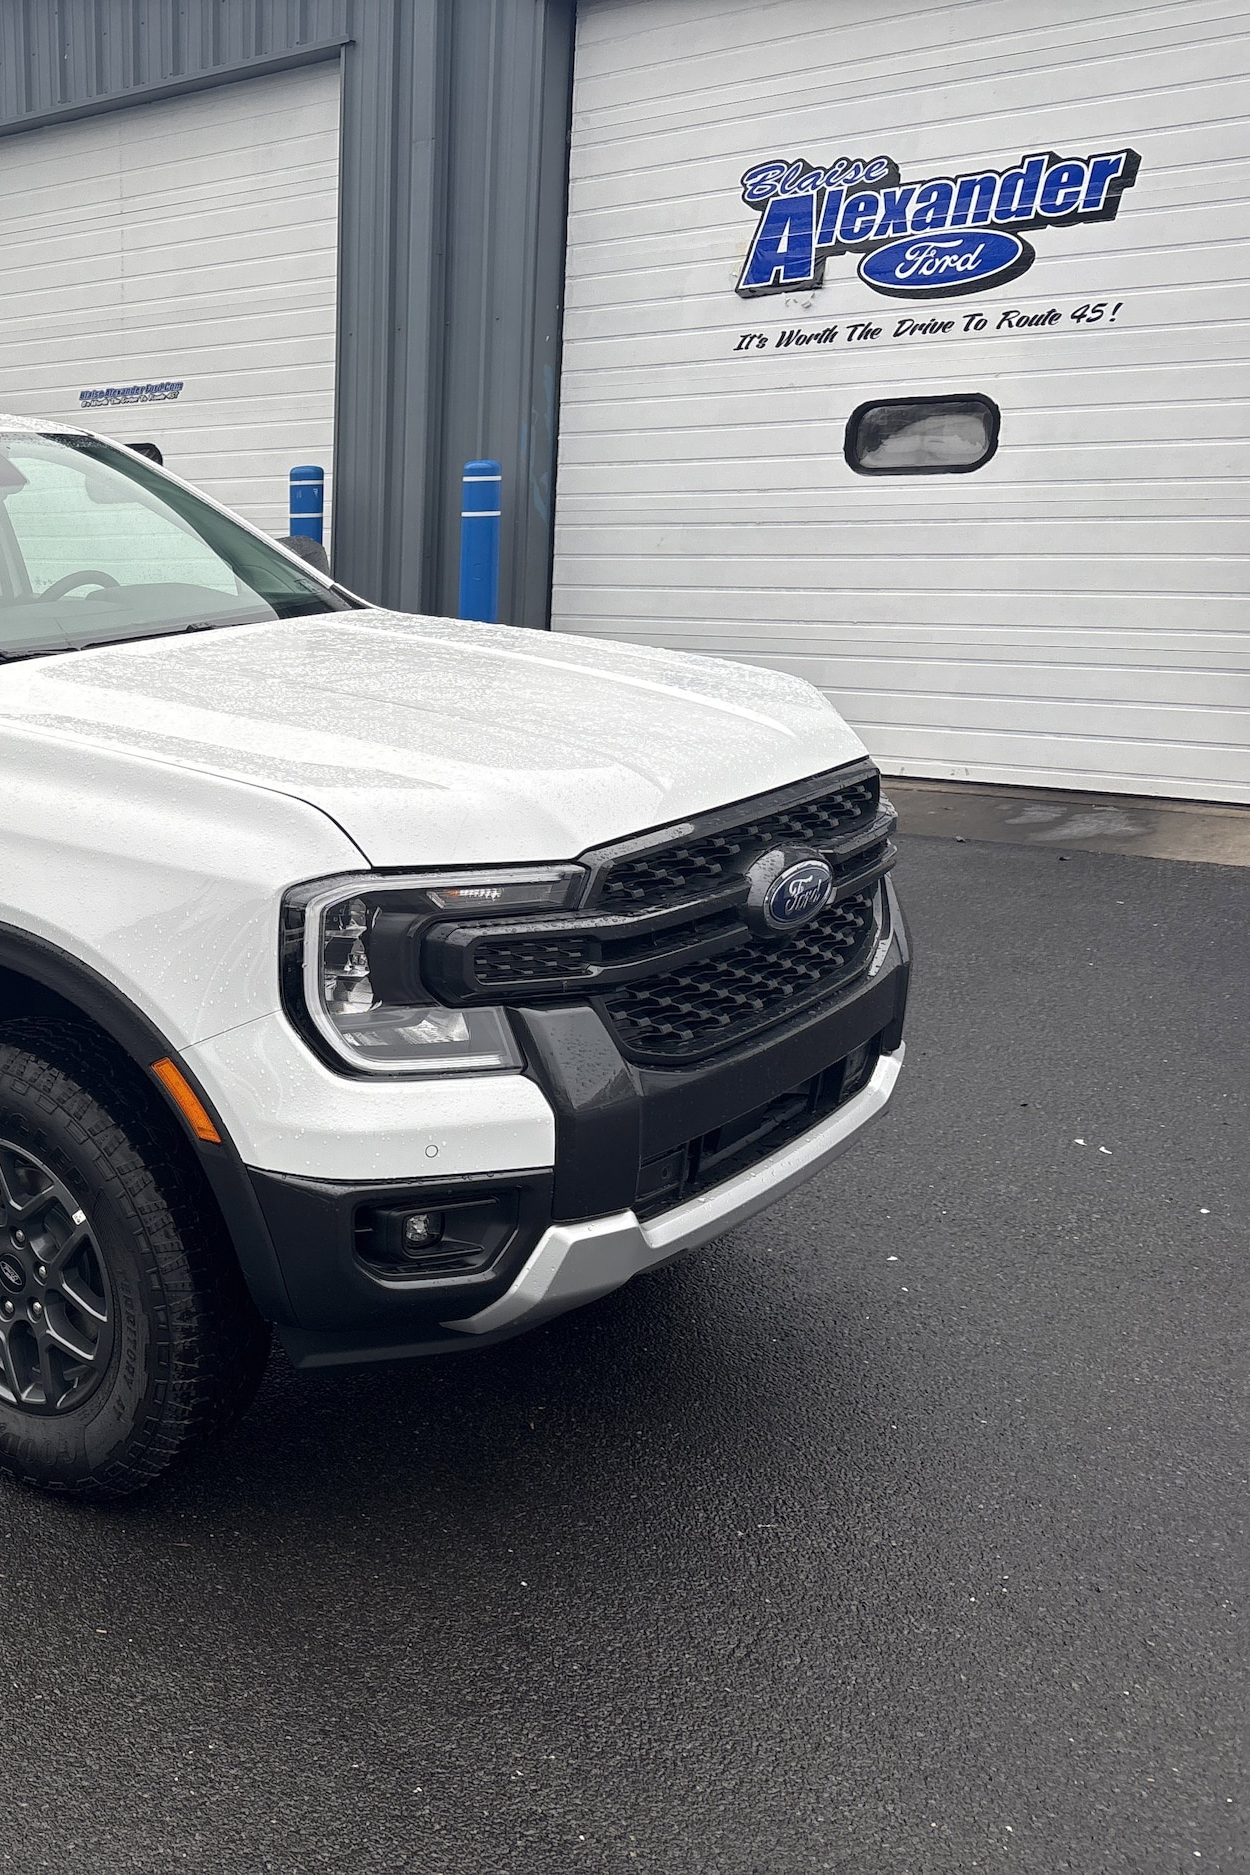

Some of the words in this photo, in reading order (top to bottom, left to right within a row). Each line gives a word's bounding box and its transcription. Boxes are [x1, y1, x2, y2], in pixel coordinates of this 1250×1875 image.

[740, 156, 889, 201] Blaise
[738, 151, 1128, 289] Alexander
[895, 239, 984, 279] Ford
[733, 334, 767, 351] It's
[775, 327, 838, 349] Worth
[846, 322, 882, 342] The
[892, 317, 955, 339] Drive
[962, 313, 989, 333] To
[996, 308, 1061, 331] Route
